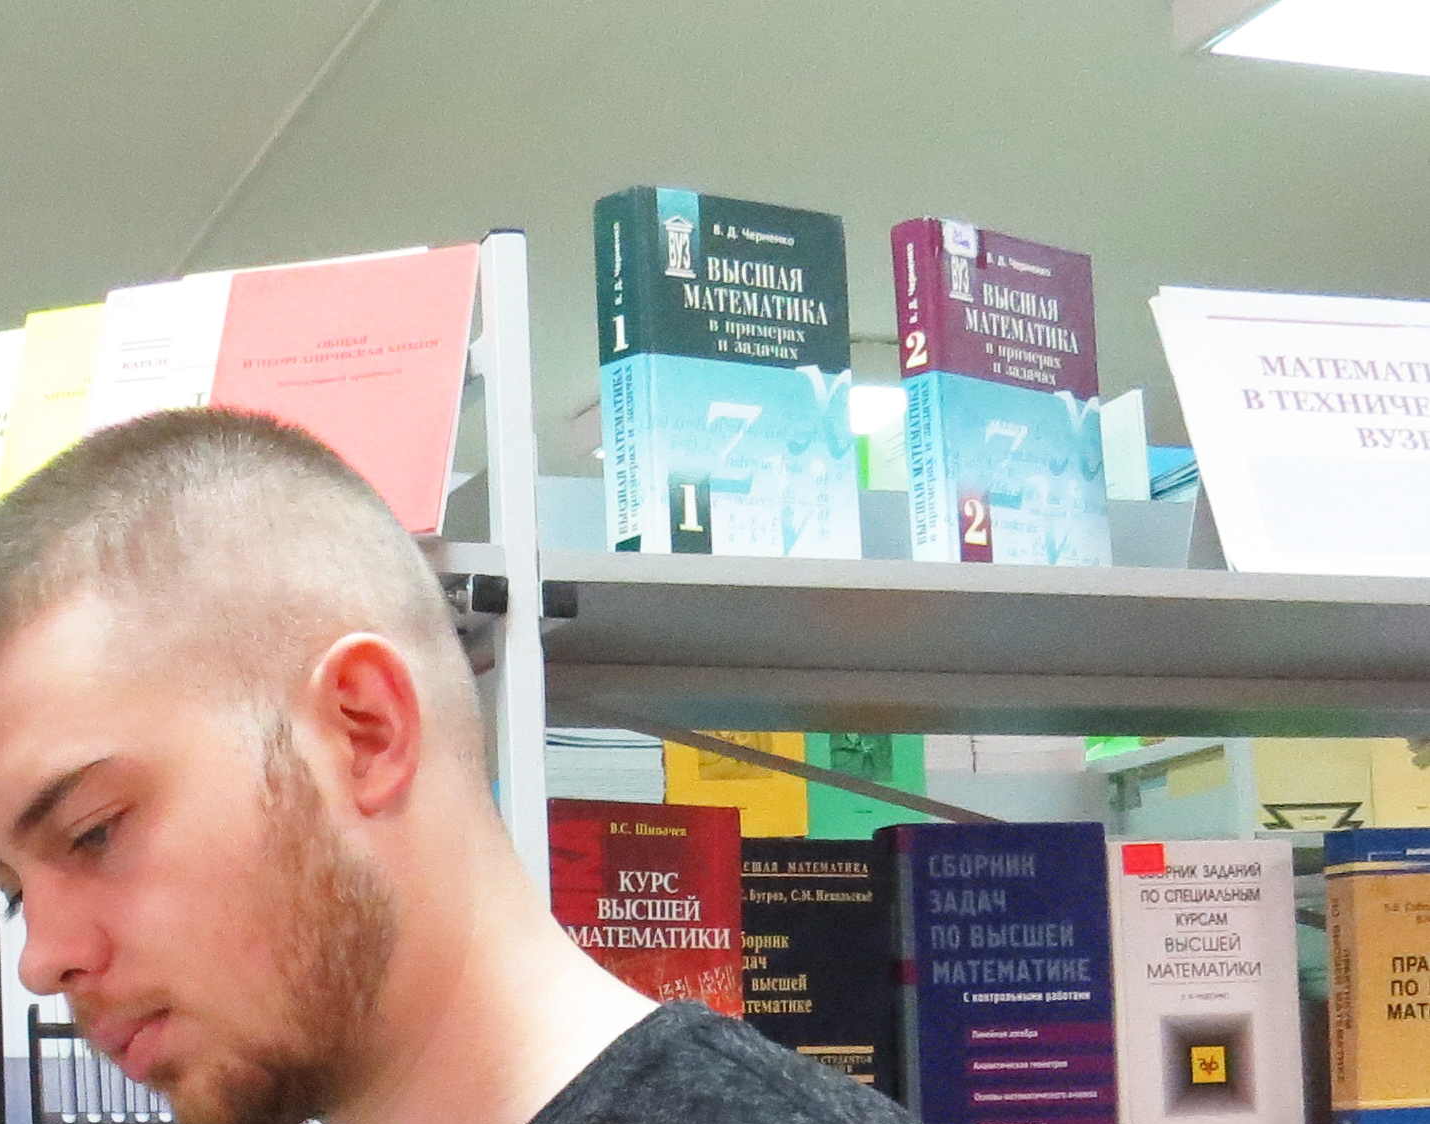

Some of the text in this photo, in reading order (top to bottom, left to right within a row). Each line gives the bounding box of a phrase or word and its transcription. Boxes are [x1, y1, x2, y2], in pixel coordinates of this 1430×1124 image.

[713, 222, 723, 237] В.
[707, 256, 805, 294] ВЫСШАЯ
[683, 282, 829, 327] МАТЕМАТИКА
[982, 283, 1059, 323] ВЫСШАЯ
[611, 314, 630, 353] 1
[724, 320, 806, 345] примерах
[964, 307, 1081, 356] МАТЕМАТИКА
[733, 339, 799, 362] задачах
[905, 331, 928, 370] 2
[1242, 388, 1265, 410] В
[678, 484, 704, 533] 1
[963, 498, 989, 546] 2
[787, 861, 869, 874] МАТЕМАТИКА
[928, 854, 1036, 880] СБОРНИК
[1202, 861, 1262, 880] ЗАДАНИЙ
[619, 871, 680, 895] КУРС
[1140, 887, 1261, 904] ПО СПЕЦИАЛЬНЫМ
[597, 894, 702, 923] ВЫСШЕЙ
[929, 889, 1007, 916] ЗАДАЧ
[1174, 912, 1229, 927] КУРСАМ
[566, 925, 733, 951] МАТЕМАТИКИ
[930, 921, 1075, 950] ПО ВЫСШЕЙ
[1164, 932, 1242, 953] ВЫСШЕЙ
[751, 973, 808, 992] высшей
[932, 958, 1092, 985] МАТЕМАТИКЕ
[1147, 961, 1262, 979] МАТЕМАТИКИ
[1045, 990, 1092, 1003] работами
[1391, 979, 1419, 997] ПО
